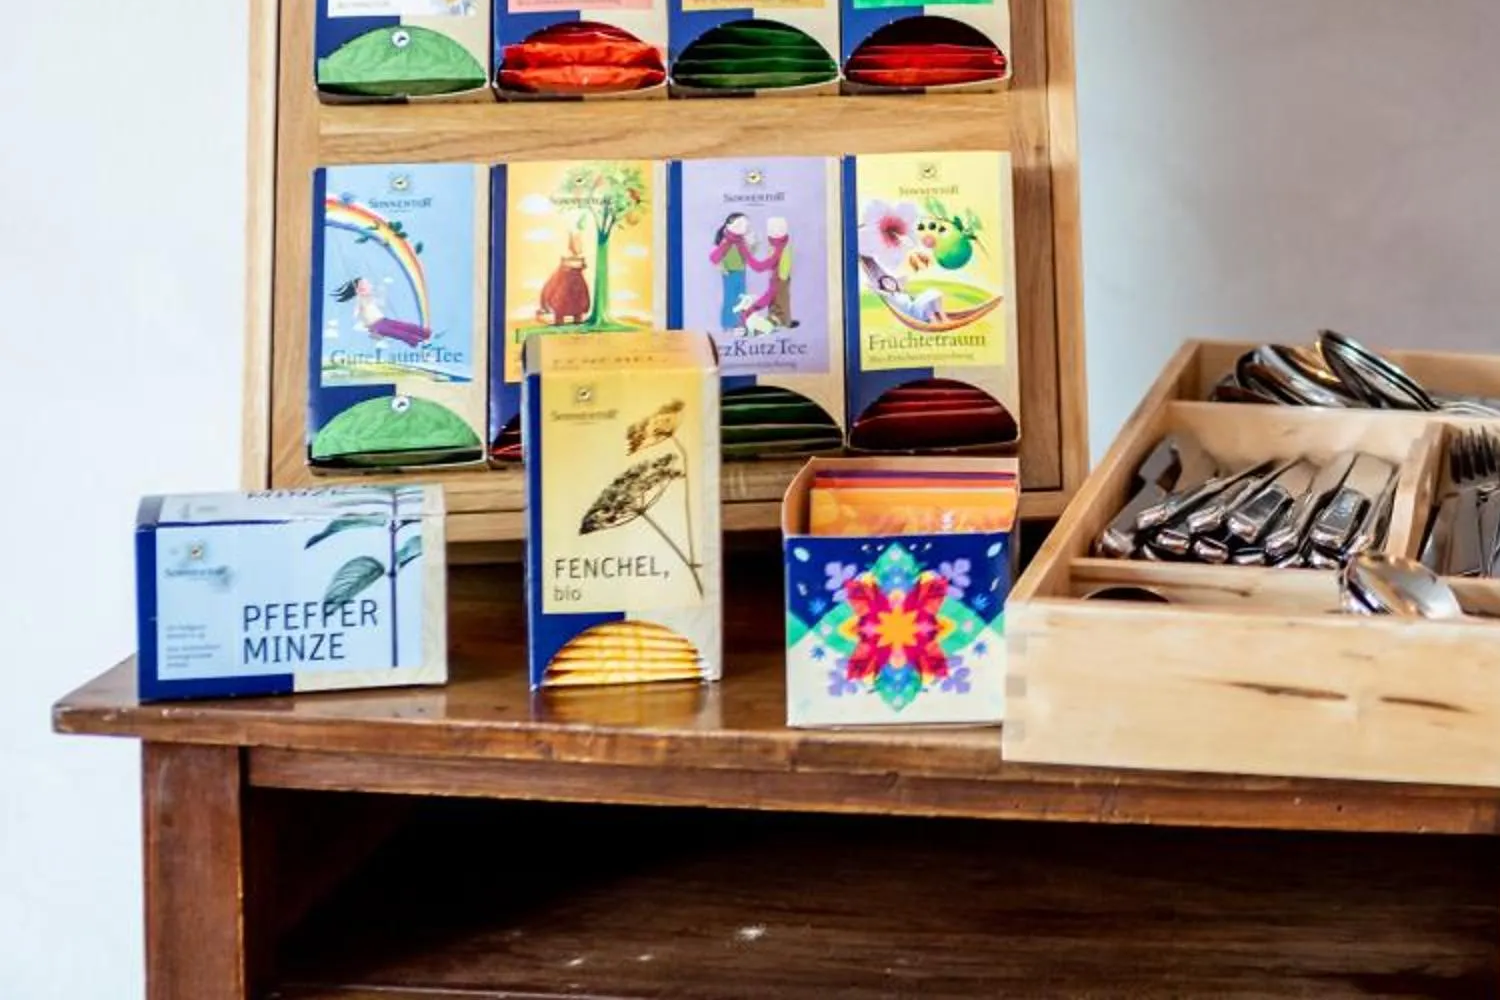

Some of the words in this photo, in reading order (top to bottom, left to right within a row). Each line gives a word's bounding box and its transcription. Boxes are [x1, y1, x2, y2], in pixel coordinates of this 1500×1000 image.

[868, 331, 987, 351] Früchtetraum
[554, 556, 669, 580] FENCHEL,
[553, 585, 581, 602] bio
[243, 599, 379, 633] PFEFFER
[243, 632, 345, 665] MINZE
